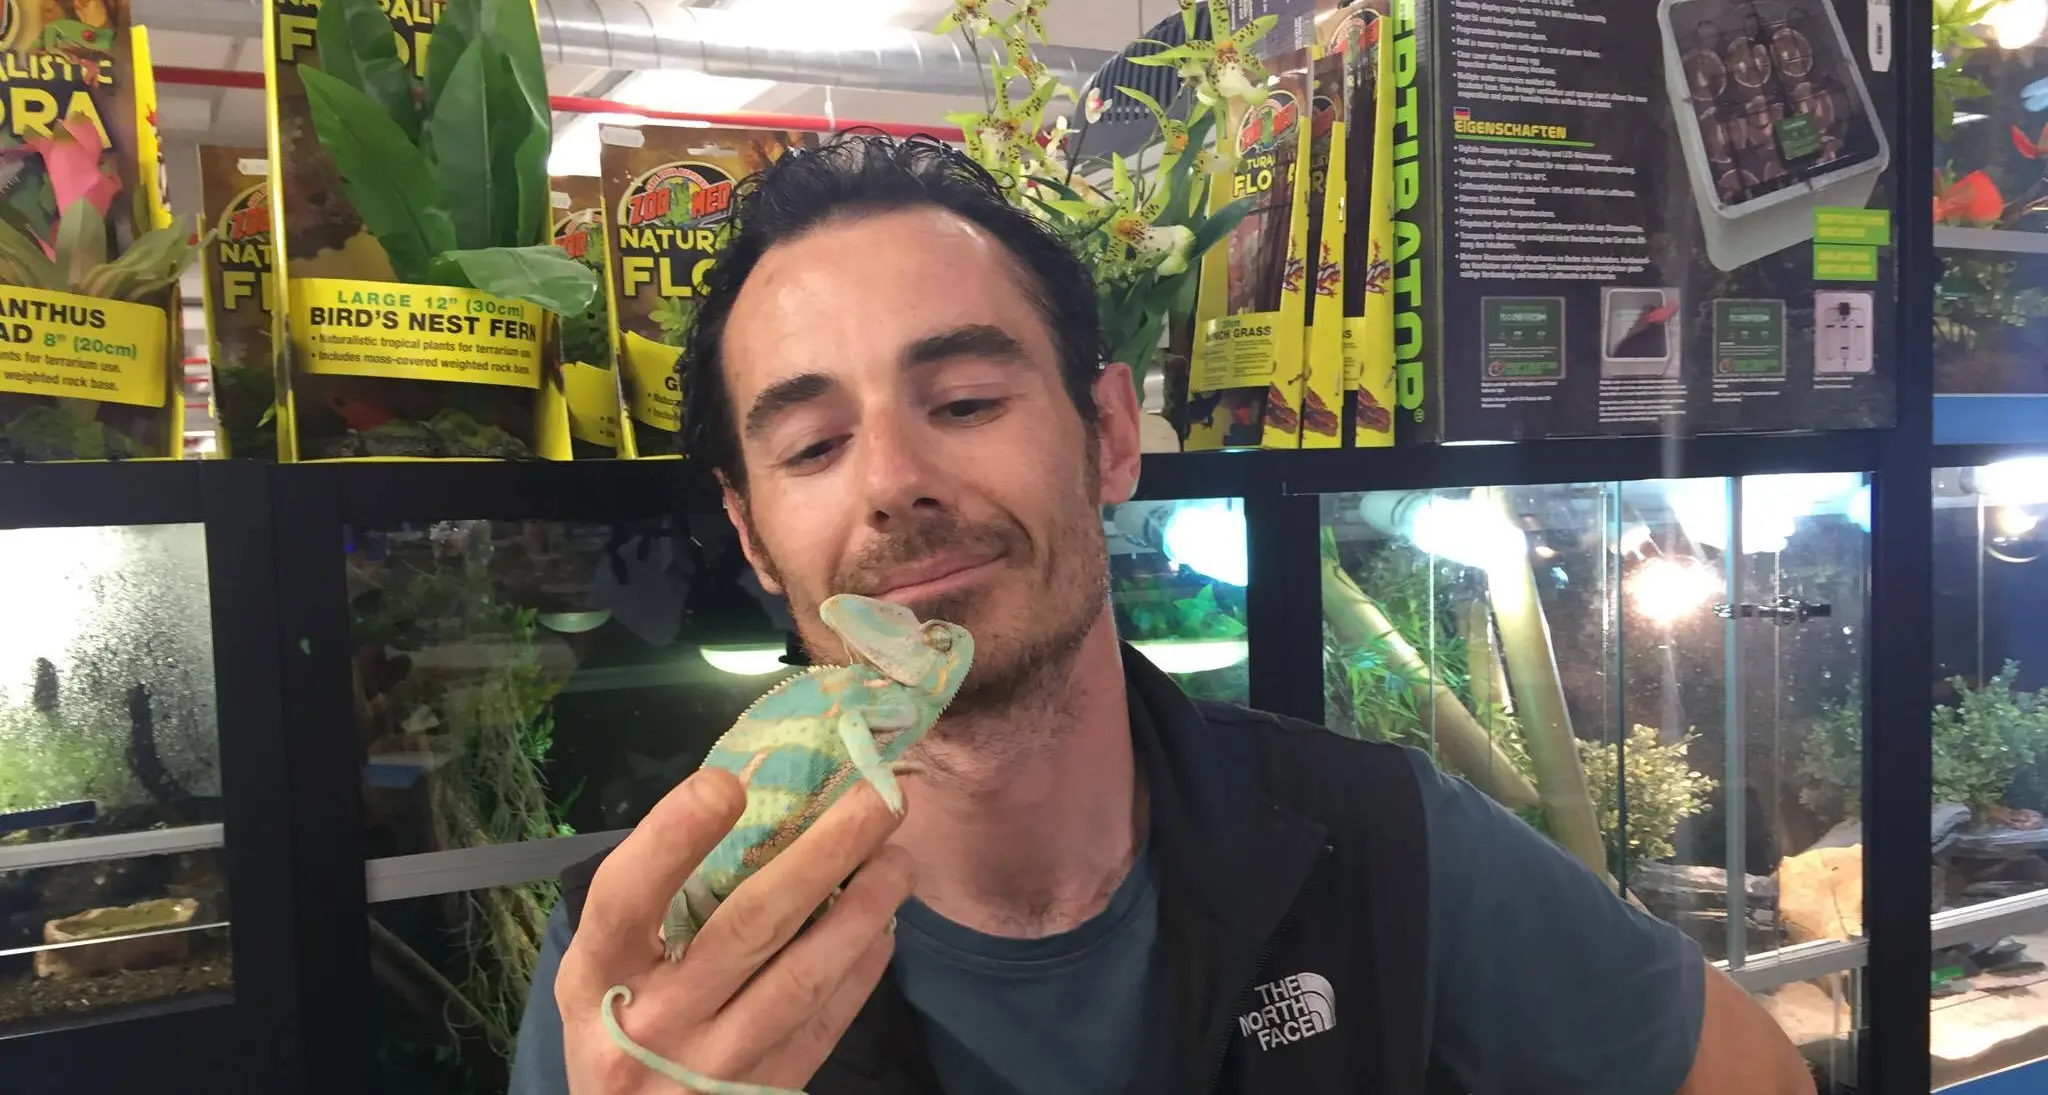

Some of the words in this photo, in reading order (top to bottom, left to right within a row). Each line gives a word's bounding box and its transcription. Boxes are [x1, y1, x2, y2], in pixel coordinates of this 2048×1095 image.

[0, 53, 113, 84] LISTC
[0, 87, 113, 148] RA
[1454, 119, 1566, 139] EIGENSCHAFTEN
[337, 290, 411, 307] LARGE
[408, 312, 480, 336] NEST
[489, 318, 536, 343] FERN
[1233, 326, 1272, 338] GRASS
[73, 335, 137, 360] (20cm)
[381, 337, 420, 350] tropical
[423, 340, 455, 352] plants
[458, 341, 473, 353] for
[441, 358, 488, 371] weighted
[1254, 975, 1302, 1004] THE
[1238, 995, 1310, 1037] NORTH
[1257, 1015, 1317, 1052] FACE
